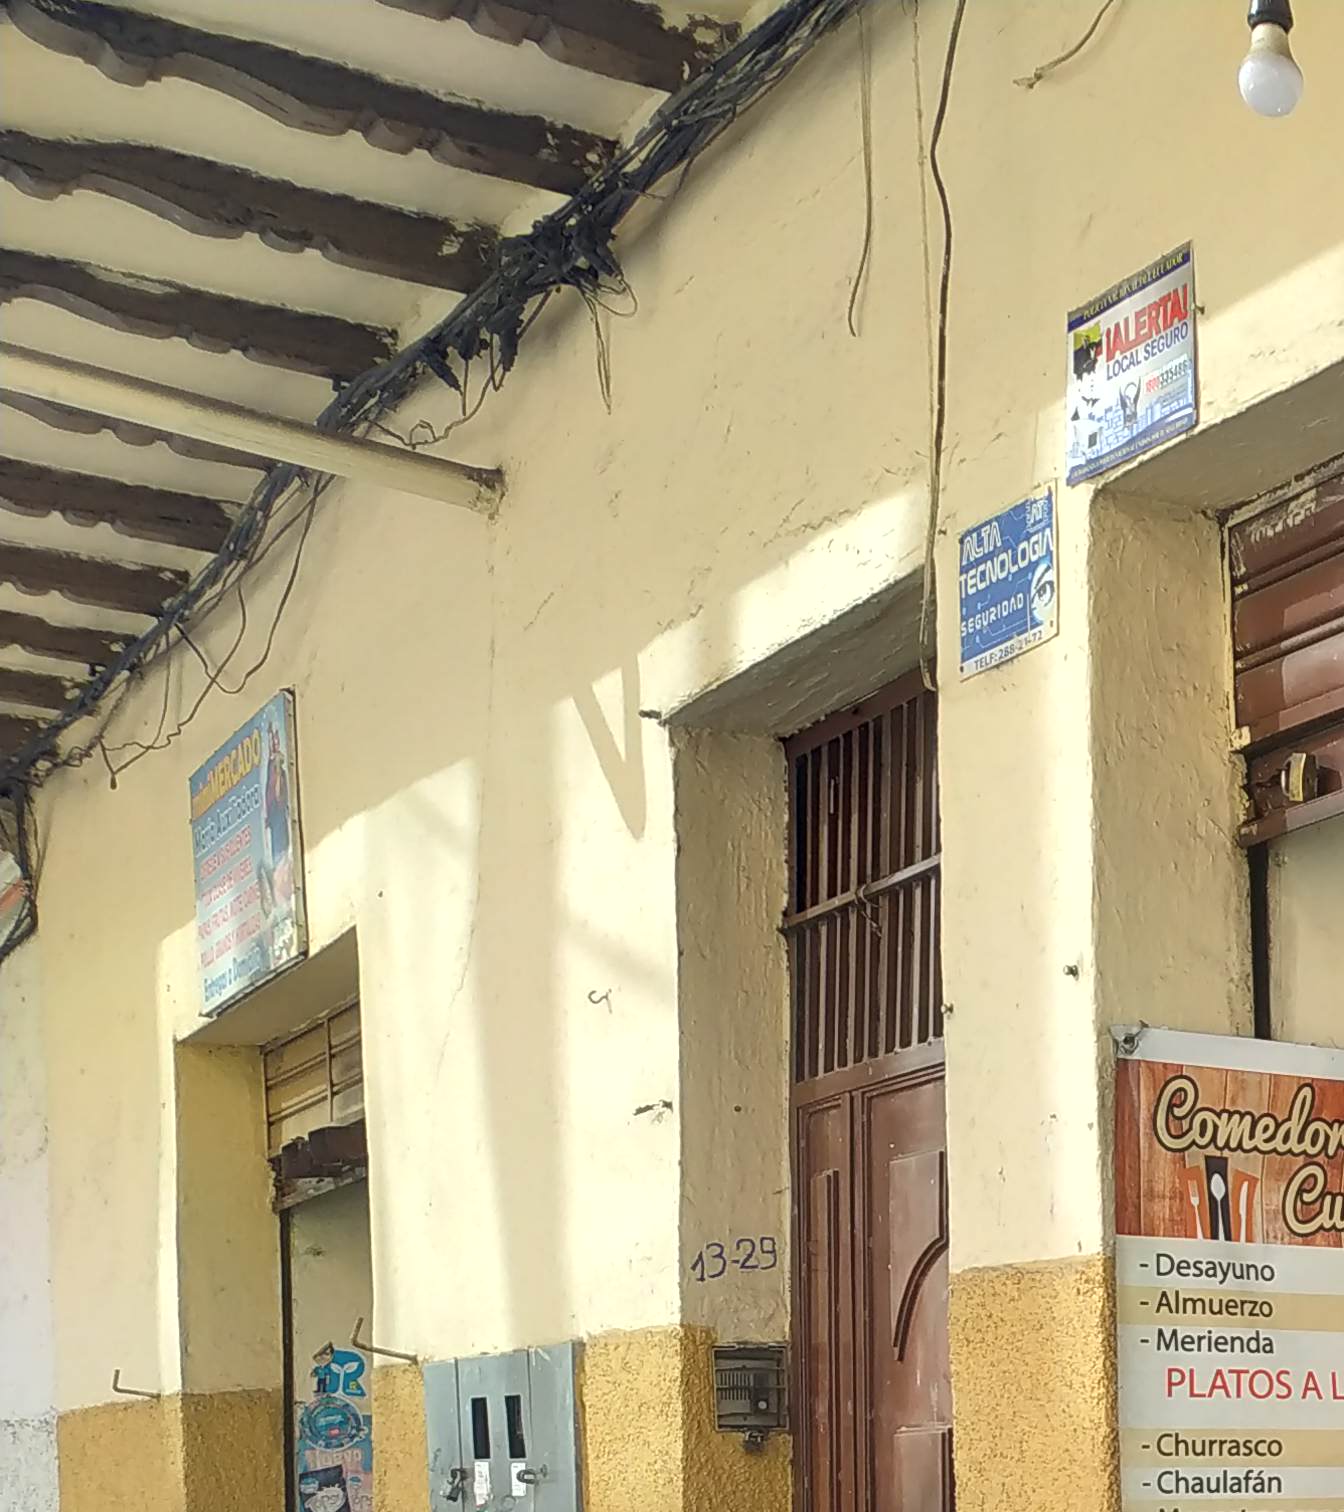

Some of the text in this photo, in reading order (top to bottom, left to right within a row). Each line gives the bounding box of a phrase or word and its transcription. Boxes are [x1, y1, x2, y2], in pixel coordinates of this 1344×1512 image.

[1105, 283, 1188, 362] ¡ALERTA!
[1107, 322, 1188, 380] LOCAL SEGURO
[960, 527, 1053, 598] TECNOLOGIA
[962, 521, 1002, 566] ALTA
[962, 593, 1024, 637] SEGURIDAD
[690, 1236, 777, 1282] 13-29
[1156, 1254, 1276, 1284] Desayuno
[1156, 1291, 1274, 1318] Almuerzo
[1156, 1328, 1274, 1354] Merienda
[1165, 1368, 1292, 1399] PLATOS
[1301, 1371, 1323, 1400] A
[1156, 1433, 1283, 1457] Churrasco
[1157, 1470, 1282, 1494] Chaulafán
